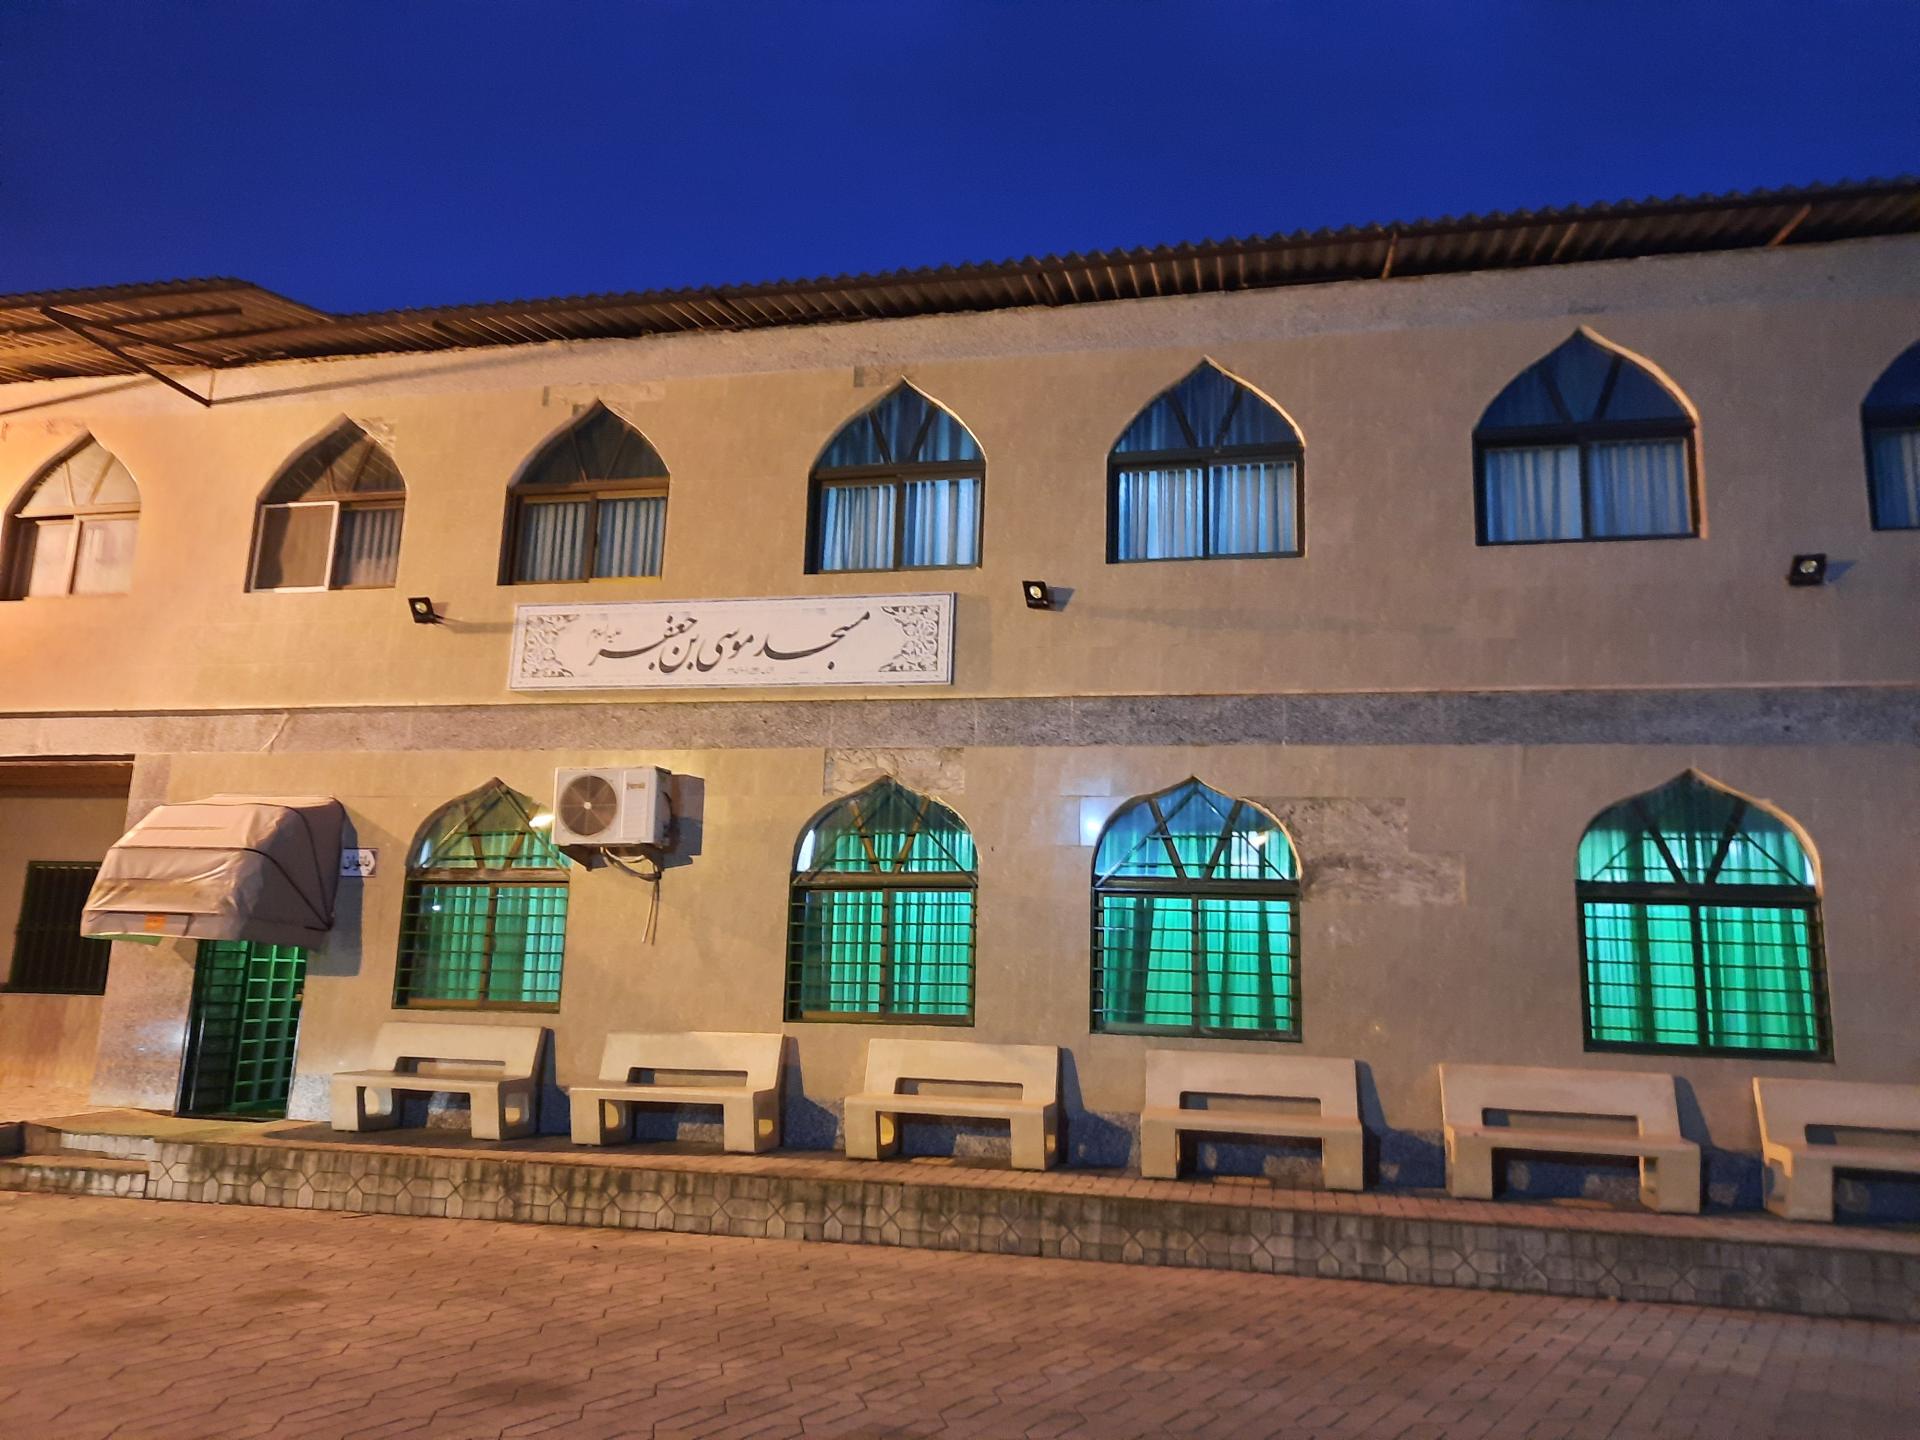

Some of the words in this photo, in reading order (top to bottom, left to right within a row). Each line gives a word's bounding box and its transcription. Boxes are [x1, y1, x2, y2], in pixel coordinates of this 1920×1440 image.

[588, 614, 698, 671] جعفر
[658, 633, 699, 674] بن
[753, 611, 871, 671] مسجد
